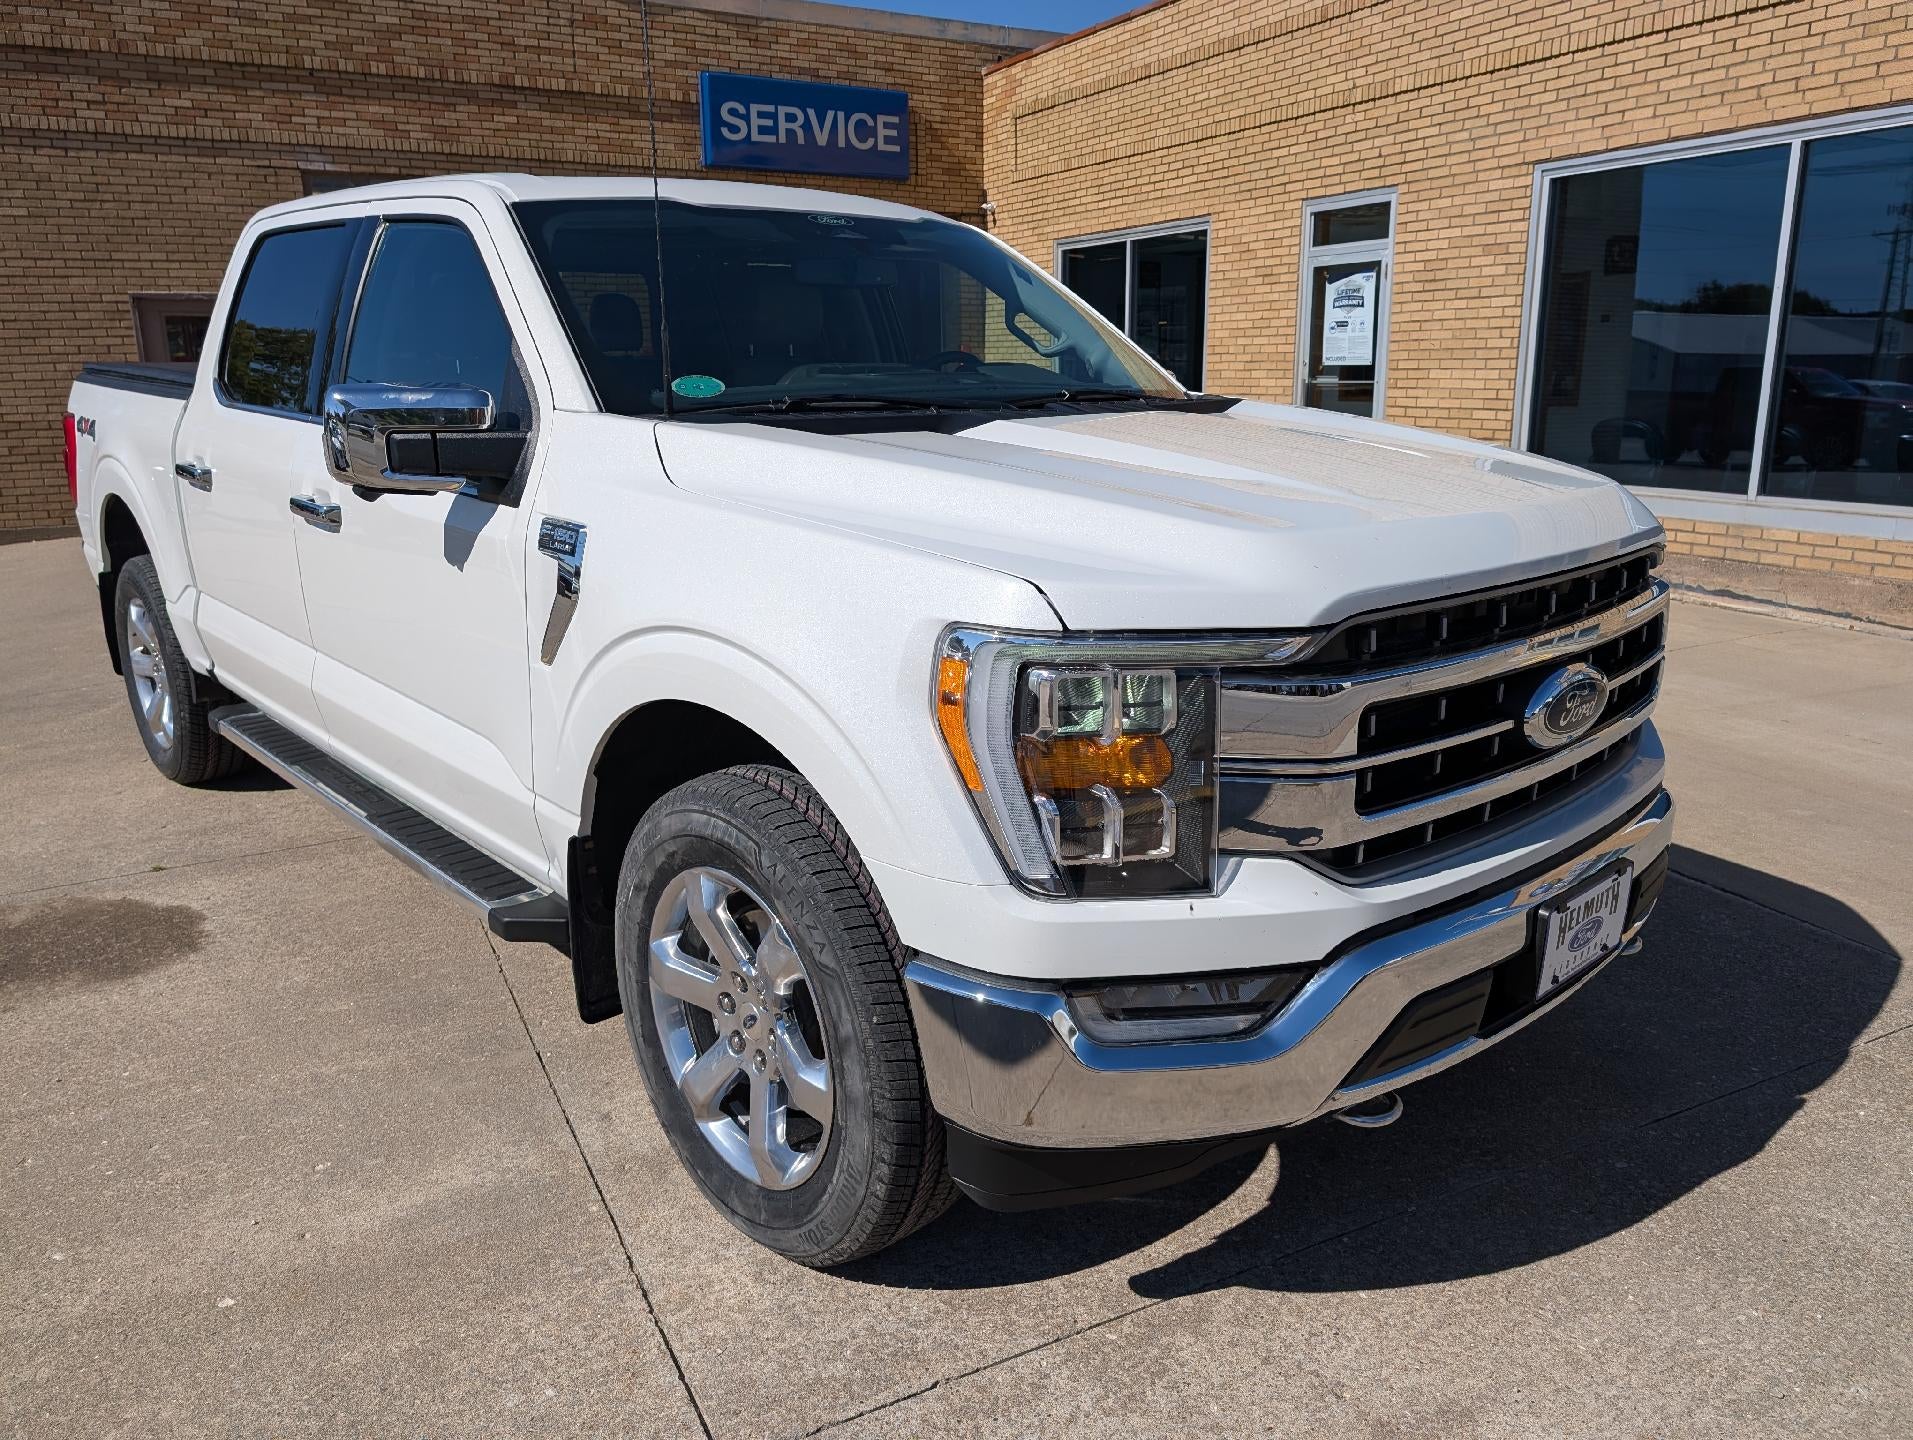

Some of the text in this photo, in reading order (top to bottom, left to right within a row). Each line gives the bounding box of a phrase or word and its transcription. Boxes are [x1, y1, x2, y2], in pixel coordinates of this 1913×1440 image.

[720, 101, 901, 152] SERVICE
[1334, 299, 1364, 308] WARRANTY
[550, 541, 572, 552] LARIAT
[1560, 689, 1598, 727] Ford
[766, 863, 827, 957] ALENZA
[1556, 881, 1620, 950] HELMUTH
